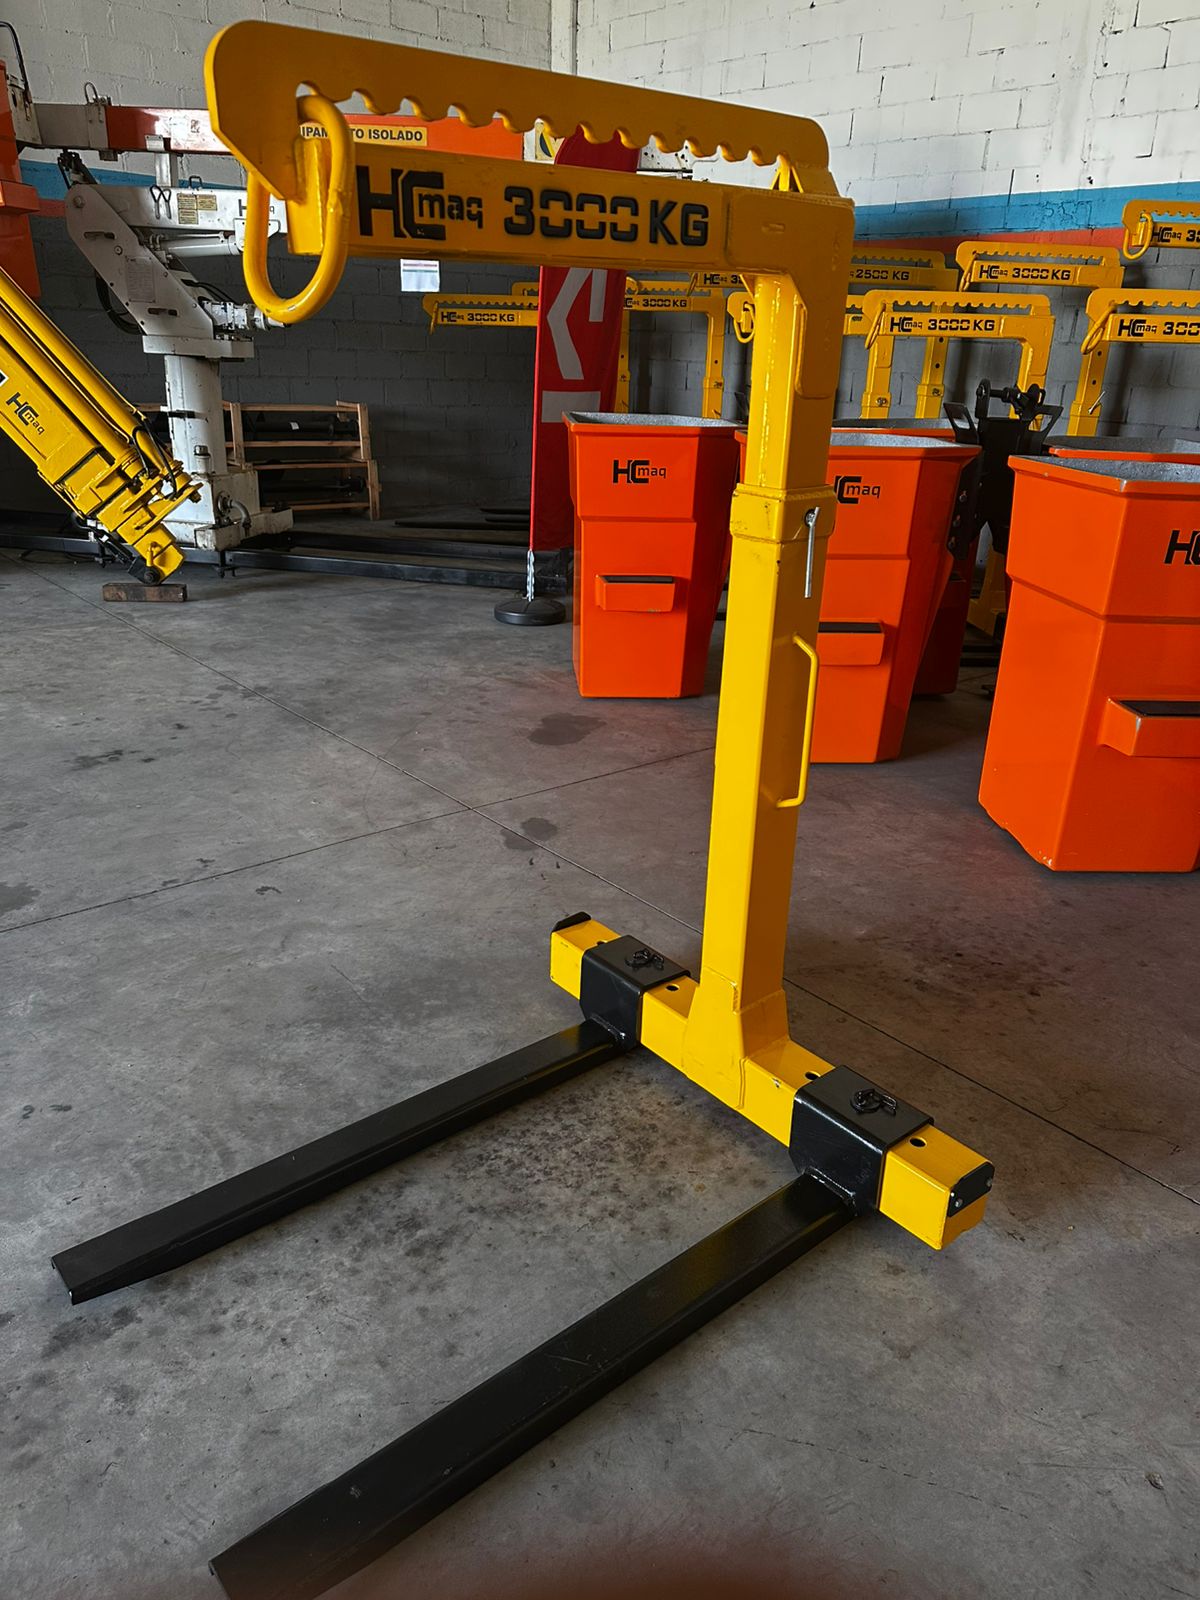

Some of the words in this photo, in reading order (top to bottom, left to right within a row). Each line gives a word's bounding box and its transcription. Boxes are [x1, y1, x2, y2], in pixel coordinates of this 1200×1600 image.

[368, 129, 423, 142] ISOLADO
[503, 185, 640, 242] 3000
[648, 199, 710, 247] KG
[855, 268, 889, 280] 2500
[892, 270, 910, 281] KG
[1012, 267, 1049, 280] 3000
[1051, 268, 1071, 281] KG
[642, 298, 671, 308] 3000
[672, 299, 687, 308] KG
[467, 312, 498, 322] 3000
[499, 313, 515, 323] KG
[927, 318, 970, 331] 3000
[973, 319, 995, 332] KG
